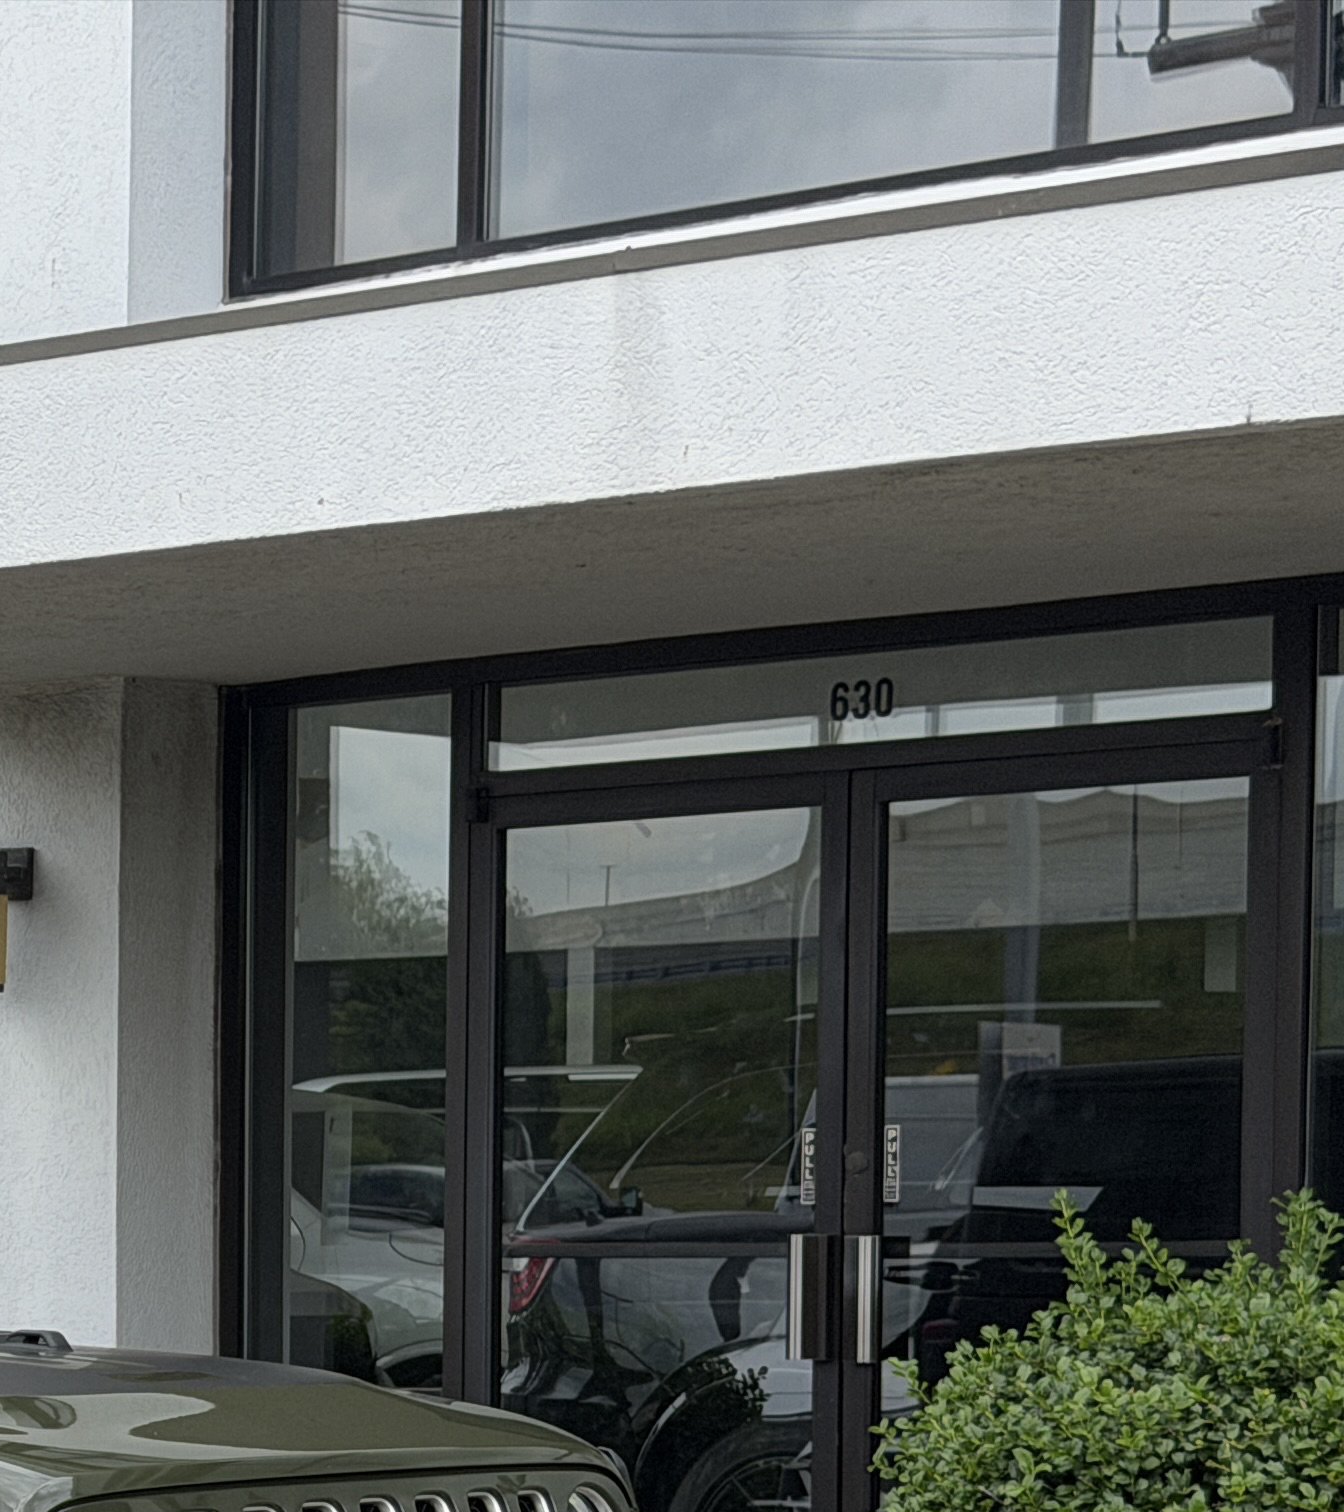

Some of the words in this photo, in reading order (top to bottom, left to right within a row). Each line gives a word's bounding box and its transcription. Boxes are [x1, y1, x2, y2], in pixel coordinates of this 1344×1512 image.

[830, 677, 894, 722] 630
[804, 1132, 815, 1180] PULL
[887, 1129, 898, 1177] PULL
